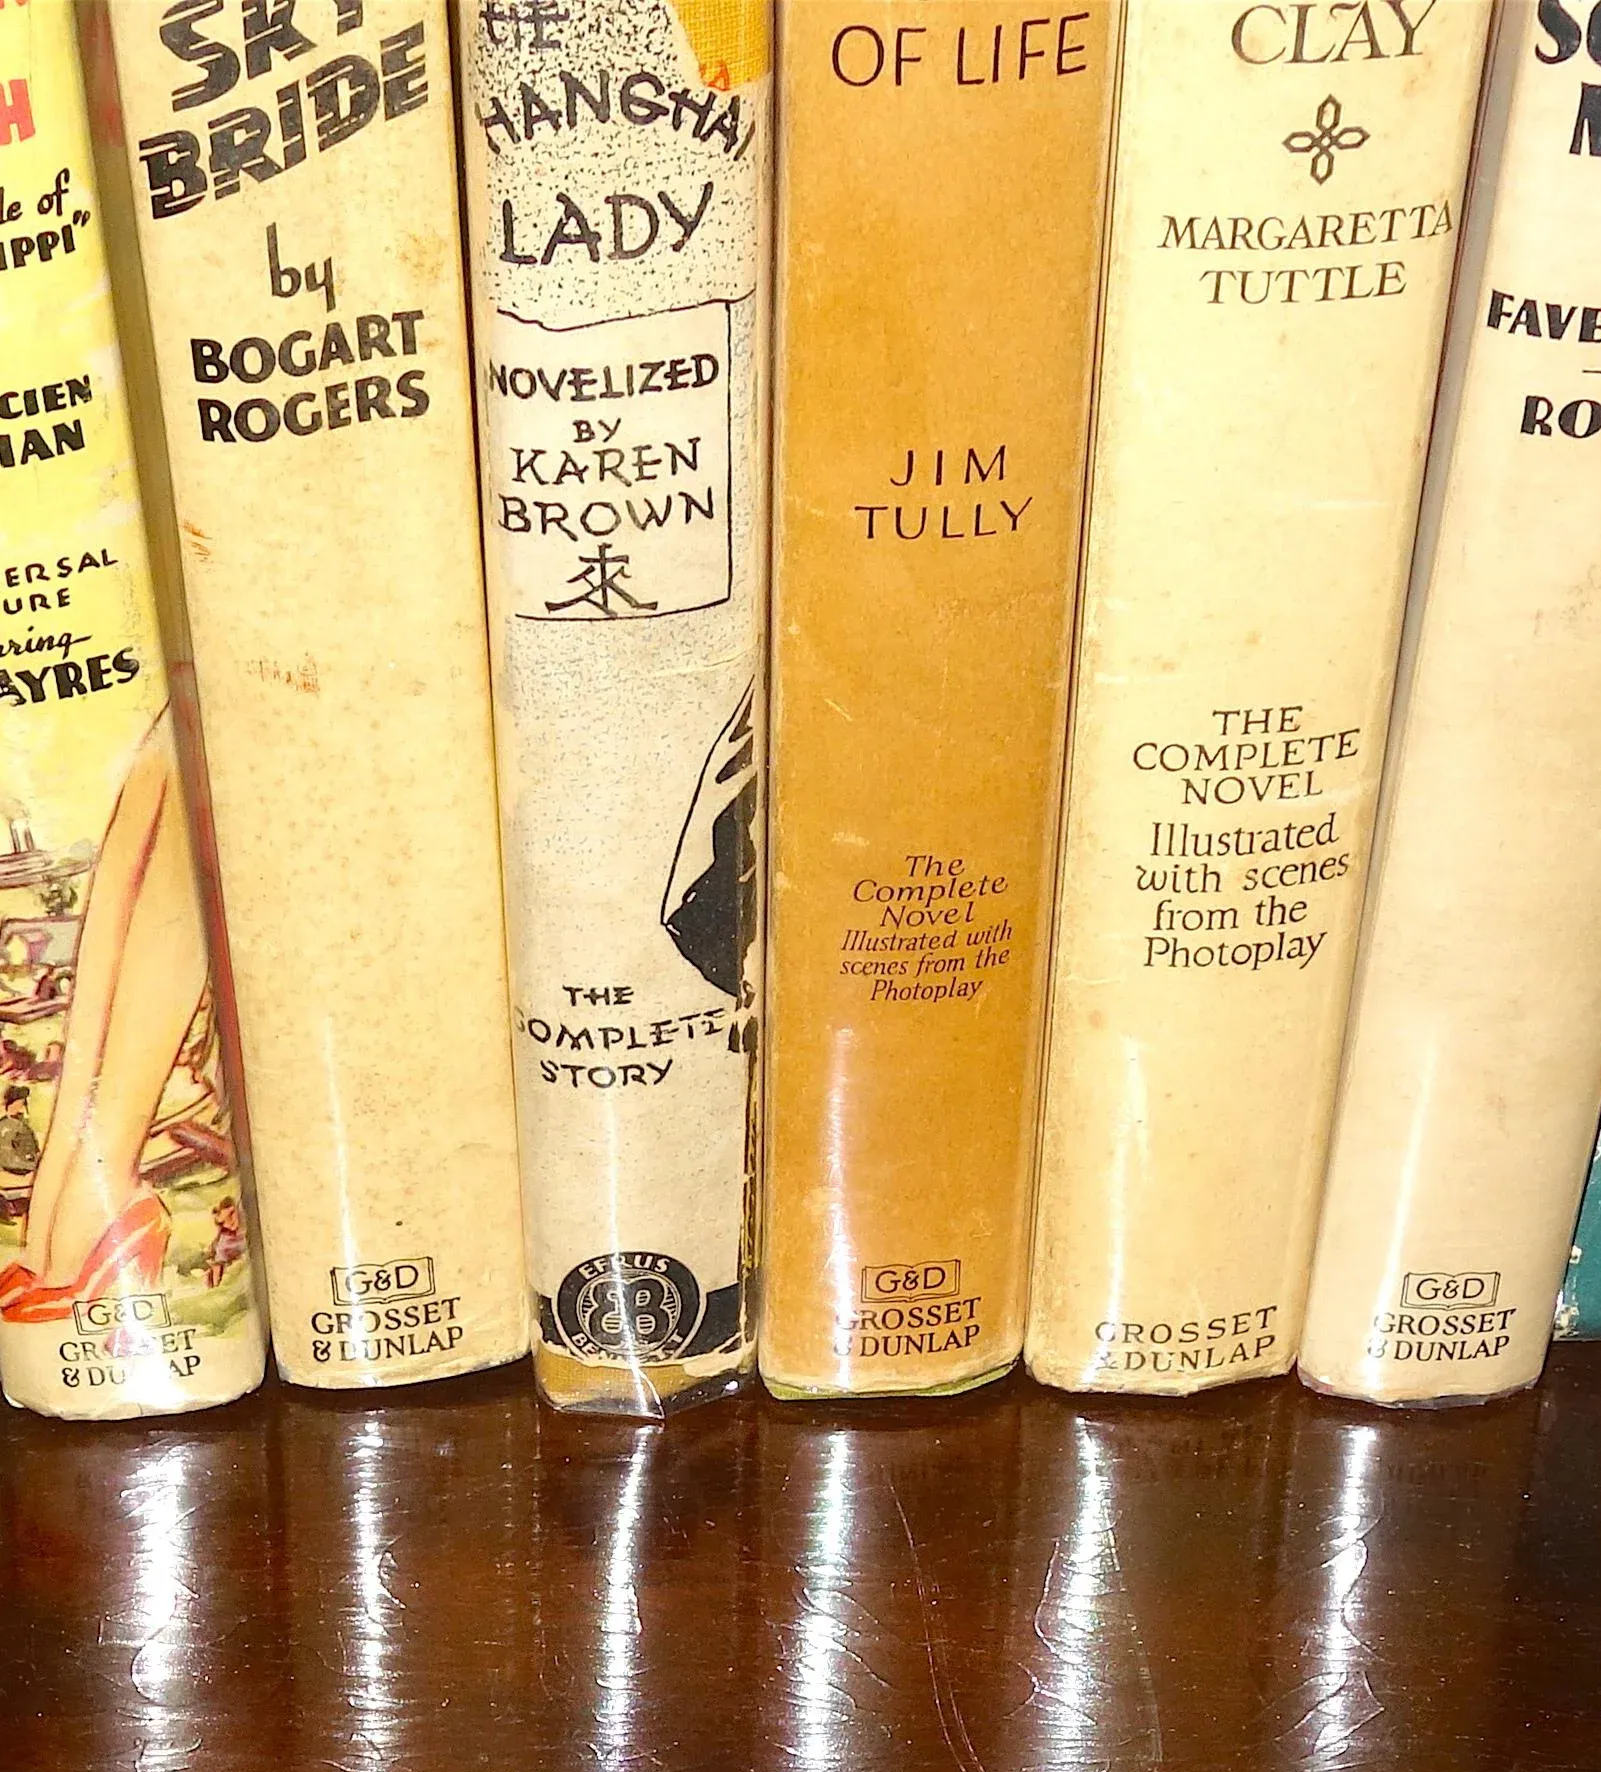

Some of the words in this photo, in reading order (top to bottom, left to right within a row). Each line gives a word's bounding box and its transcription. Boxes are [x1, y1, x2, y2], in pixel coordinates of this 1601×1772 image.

[831, 24, 927, 88] OF
[955, 12, 1091, 86] LIFE
[1232, 0, 1435, 65] CLAY
[138, 22, 431, 220] BRIDE
[37, 168, 72, 217] of
[500, 181, 714, 265] LADY
[1157, 200, 1454, 251] MARGARETTA
[265, 222, 335, 311] by
[1200, 259, 1409, 305] TUTTLE
[189, 310, 425, 384] BOGART
[488, 352, 720, 402] NOVELIZED
[198, 369, 431, 443] ROGERS
[572, 418, 621, 444] BY
[511, 437, 702, 487] KAREN
[889, 444, 1007, 487] JIM
[498, 487, 715, 541] BROWN
[854, 497, 1033, 541] TULLY
[1212, 706, 1303, 736] THE
[1133, 728, 1361, 772] COMPLETE
[1182, 770, 1323, 805] NOVEL
[1150, 812, 1340, 857] Illustrated
[904, 855, 965, 878] The
[1135, 863, 1222, 893] with
[1243, 850, 1350, 891] scenes
[852, 874, 1008, 906] Complete
[879, 902, 976, 928] Novel
[1152, 899, 1238, 931] from
[1255, 895, 1308, 927] the
[840, 929, 957, 953] Illustrated
[965, 920, 1013, 947] with
[1144, 930, 1327, 971] Photoplay
[838, 955, 909, 976] scenes
[916, 952, 968, 977] from
[974, 946, 1010, 970] the
[562, 985, 635, 1007] THE
[870, 976, 983, 1003] Photoplay
[540, 1059, 674, 1089] STORY
[310, 1296, 461, 1335] GROSSET
[1095, 1306, 1278, 1346] GROSSET
[311, 1340, 331, 1363] &
[339, 1326, 464, 1362] DUNLAP
[1125, 1334, 1277, 1374] DUNLAP
